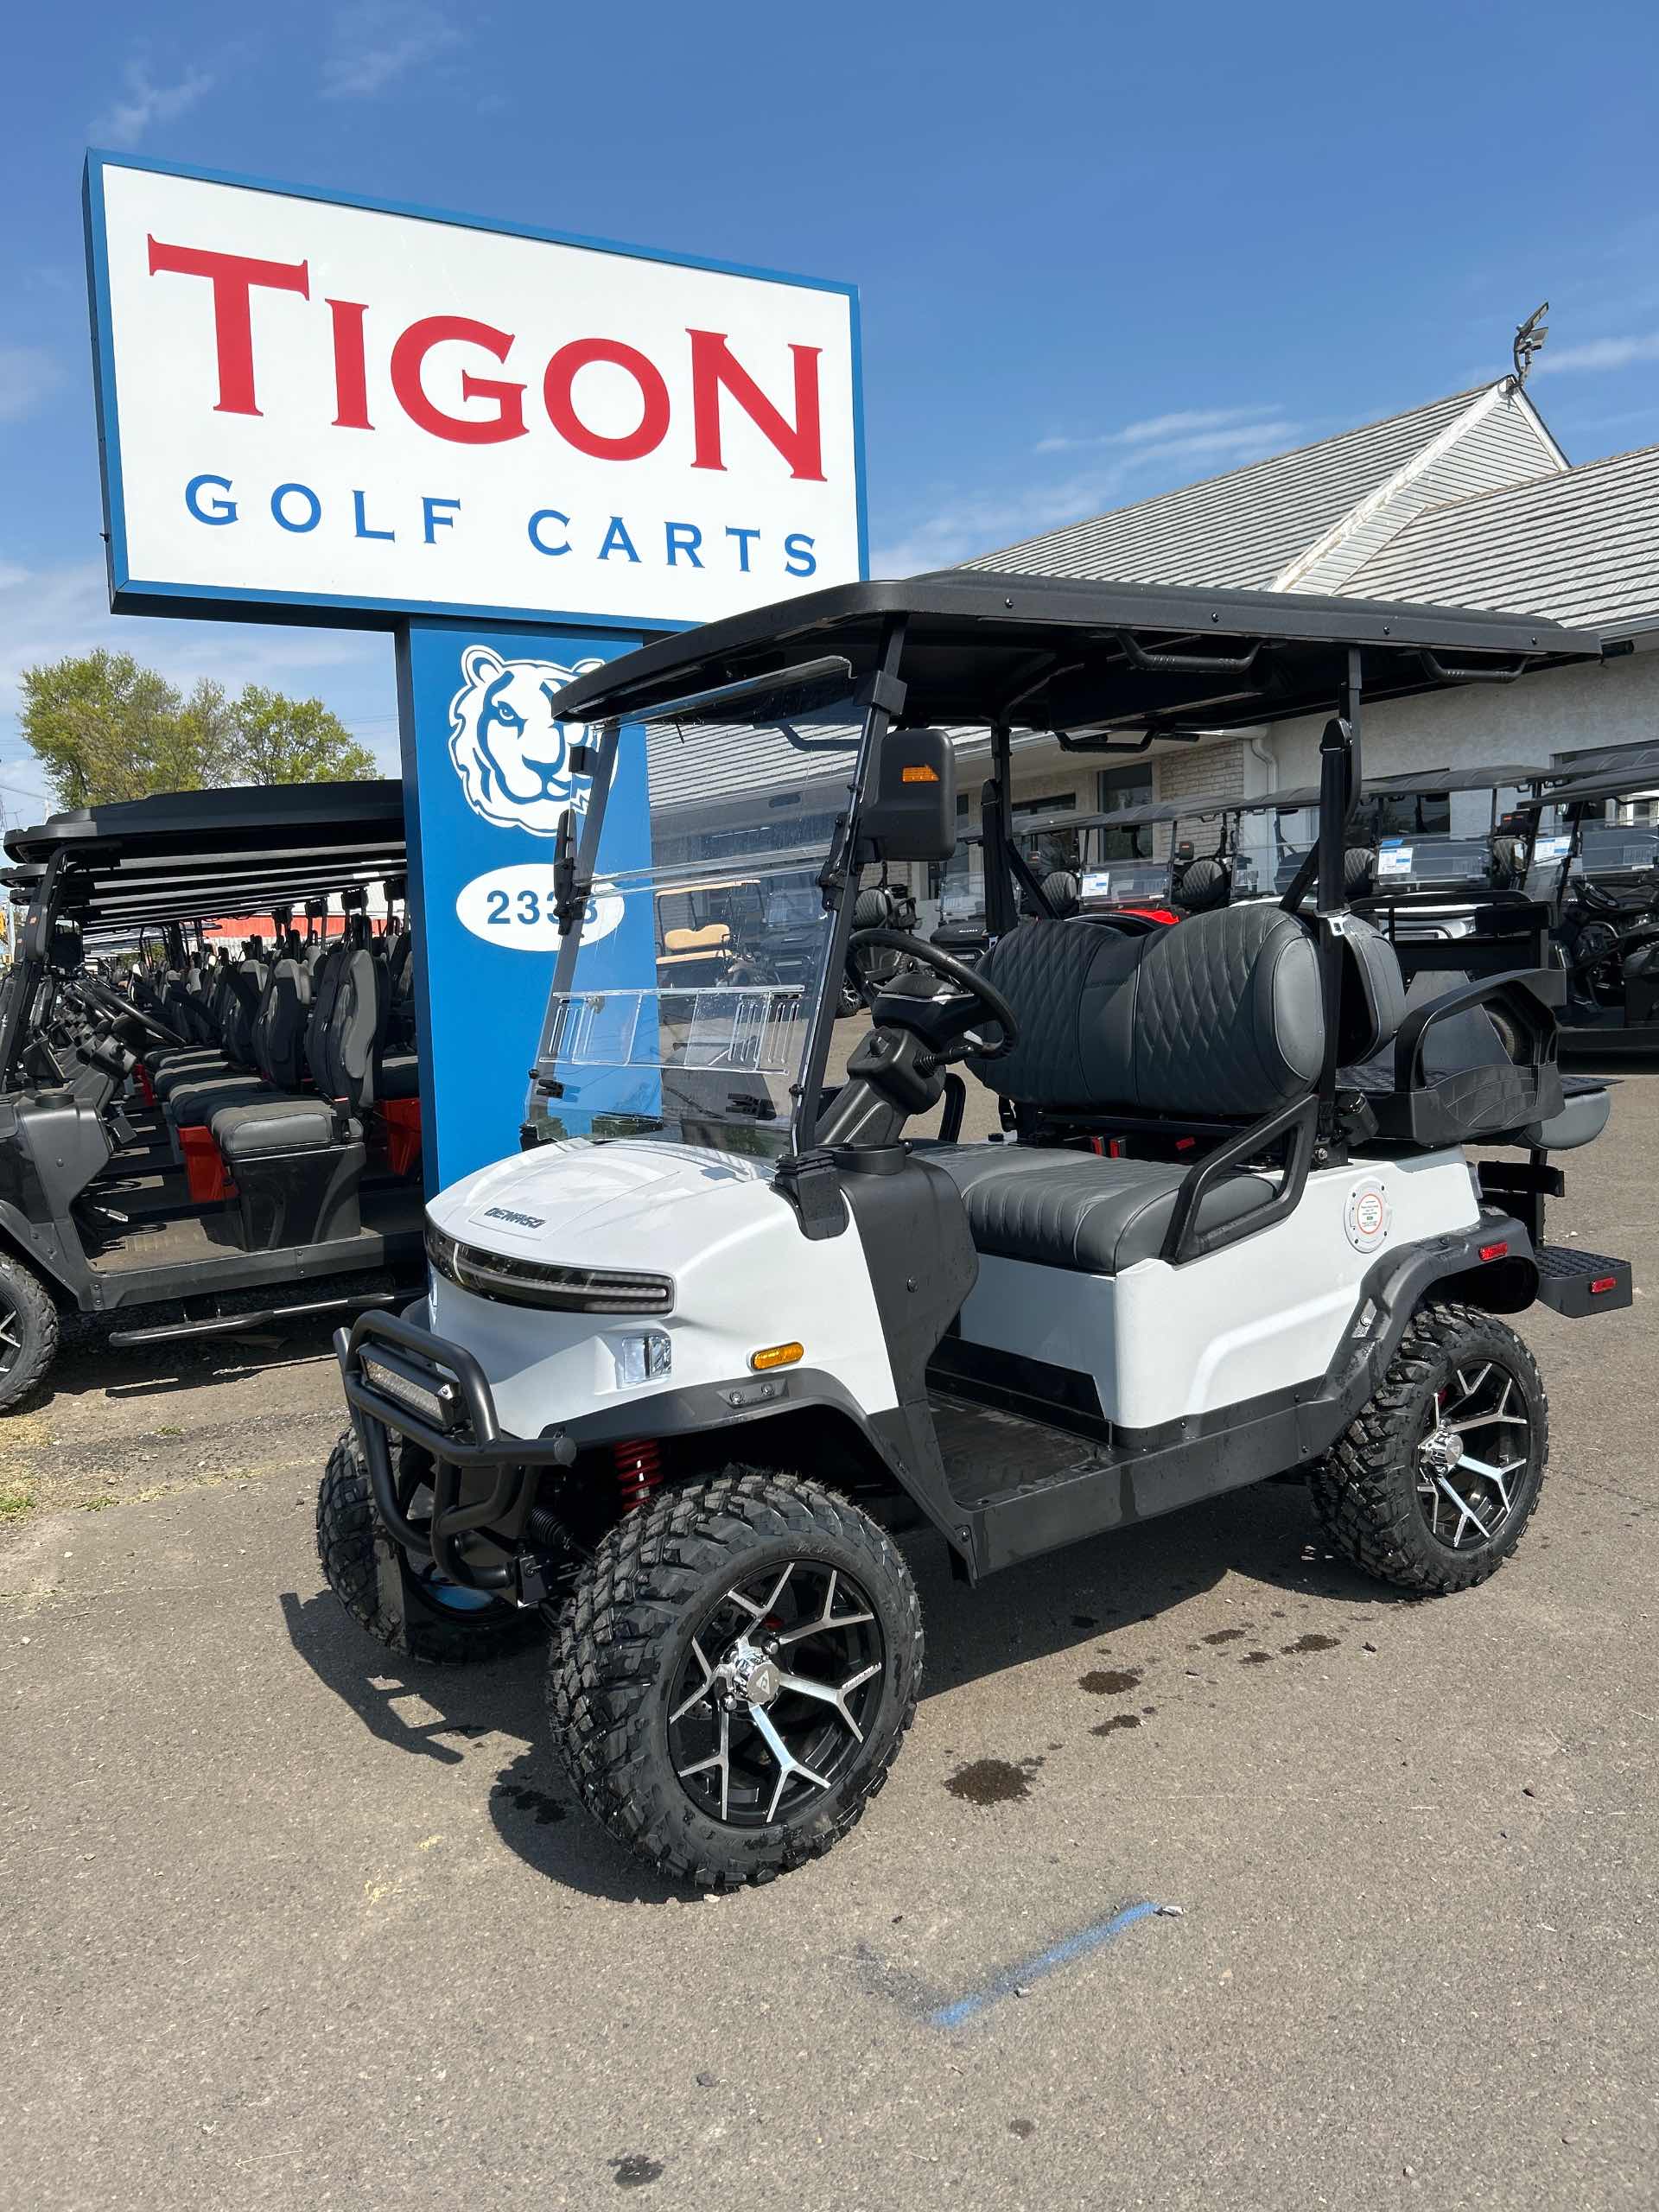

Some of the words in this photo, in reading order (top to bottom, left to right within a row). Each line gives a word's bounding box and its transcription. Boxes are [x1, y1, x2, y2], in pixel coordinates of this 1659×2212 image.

[148, 233, 827, 482] TIGON
[184, 474, 461, 544] GOLF
[527, 508, 817, 578] CARTS
